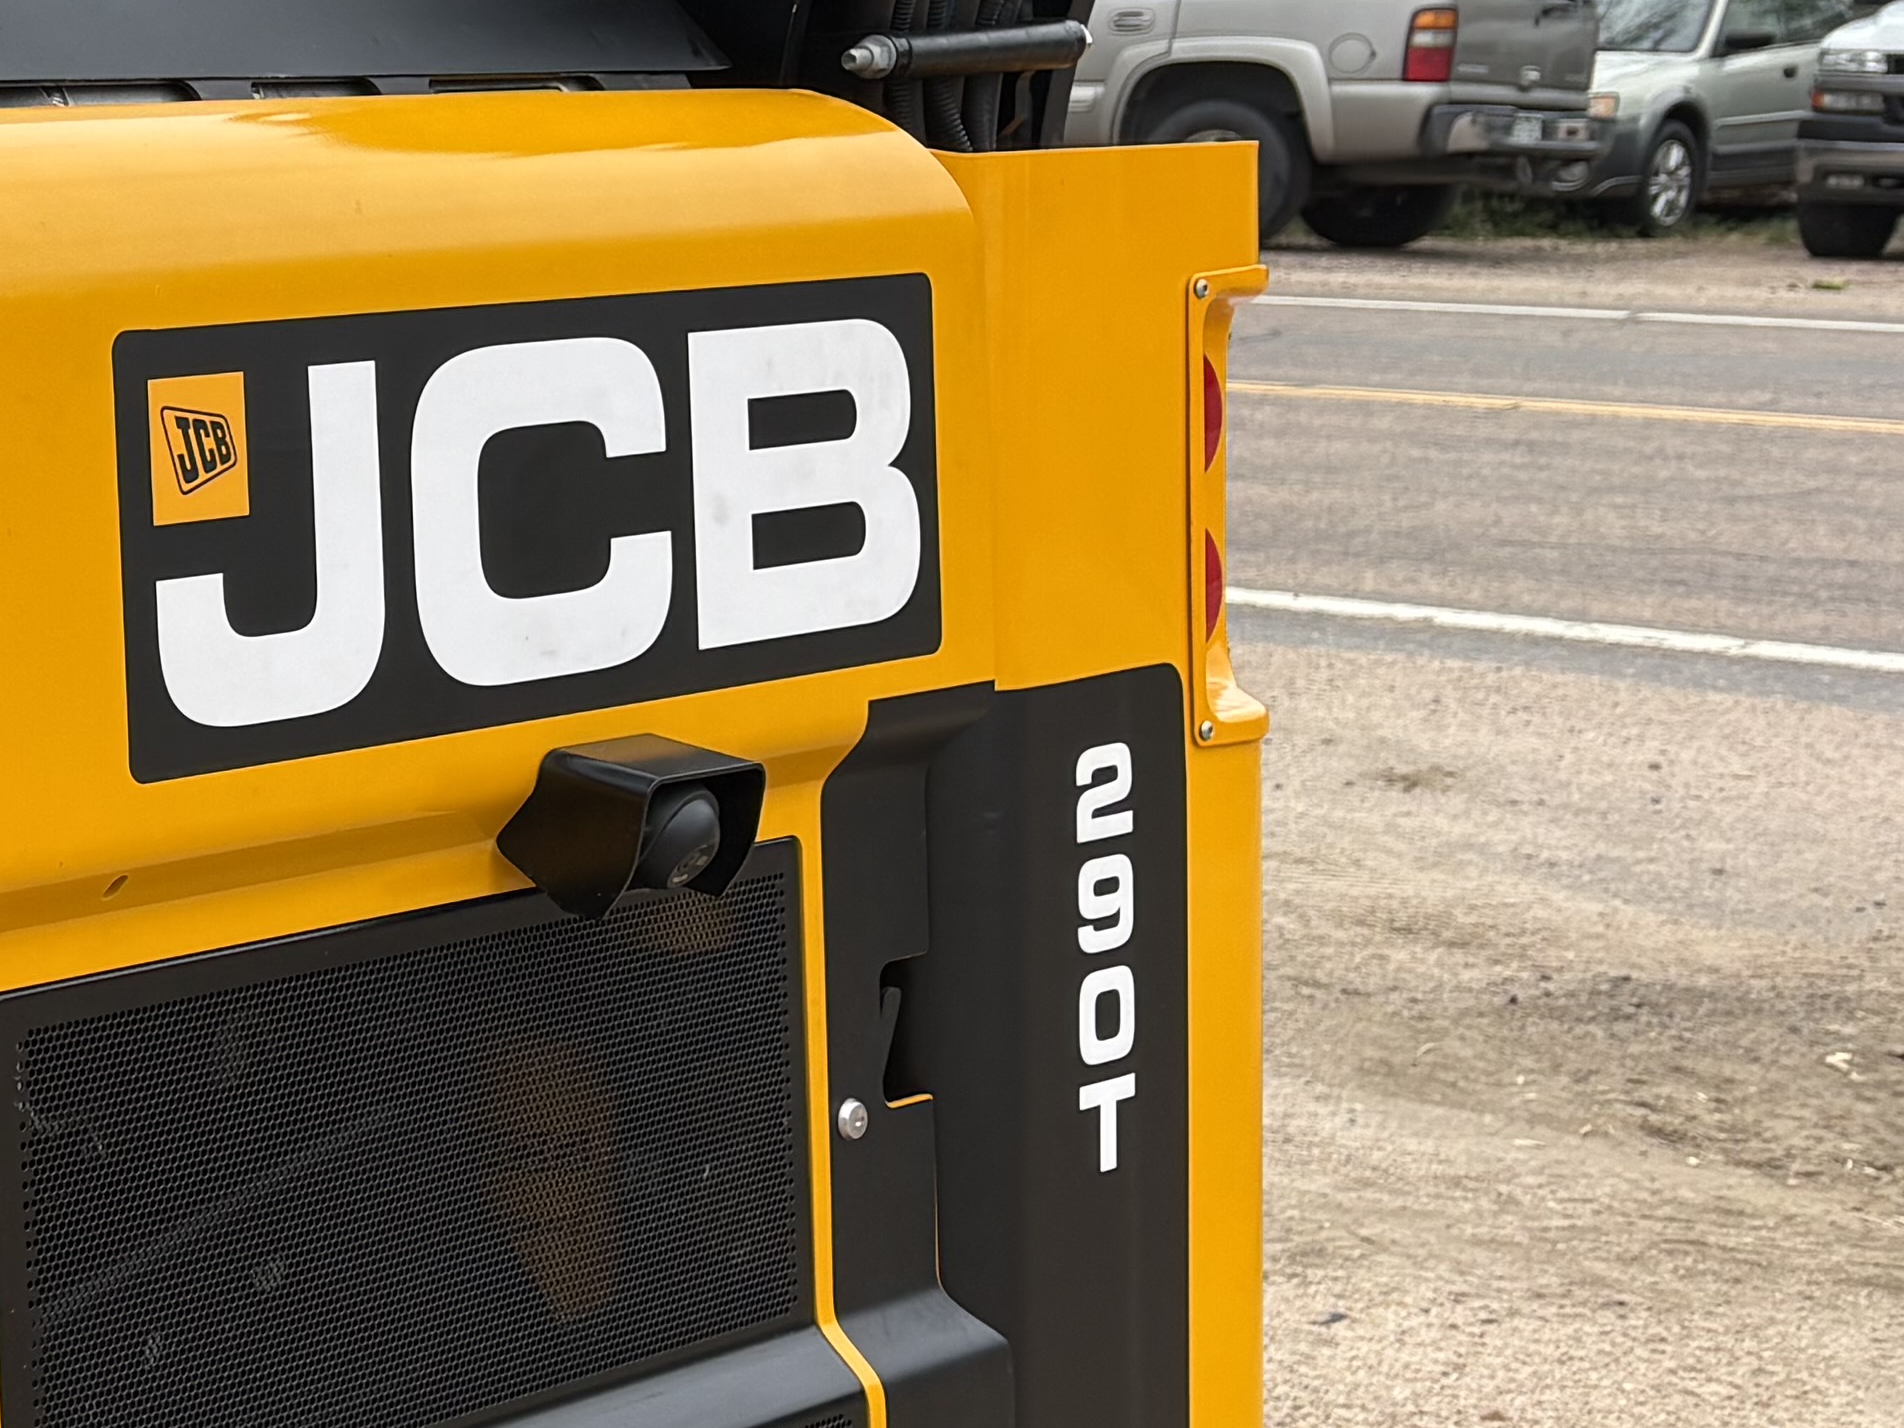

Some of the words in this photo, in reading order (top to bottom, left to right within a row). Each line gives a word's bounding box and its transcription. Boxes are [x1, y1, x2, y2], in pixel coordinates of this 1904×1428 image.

[156, 319, 921, 727] JCB
[174, 415, 233, 484] JCB
[1075, 742, 1136, 1173] 290T
